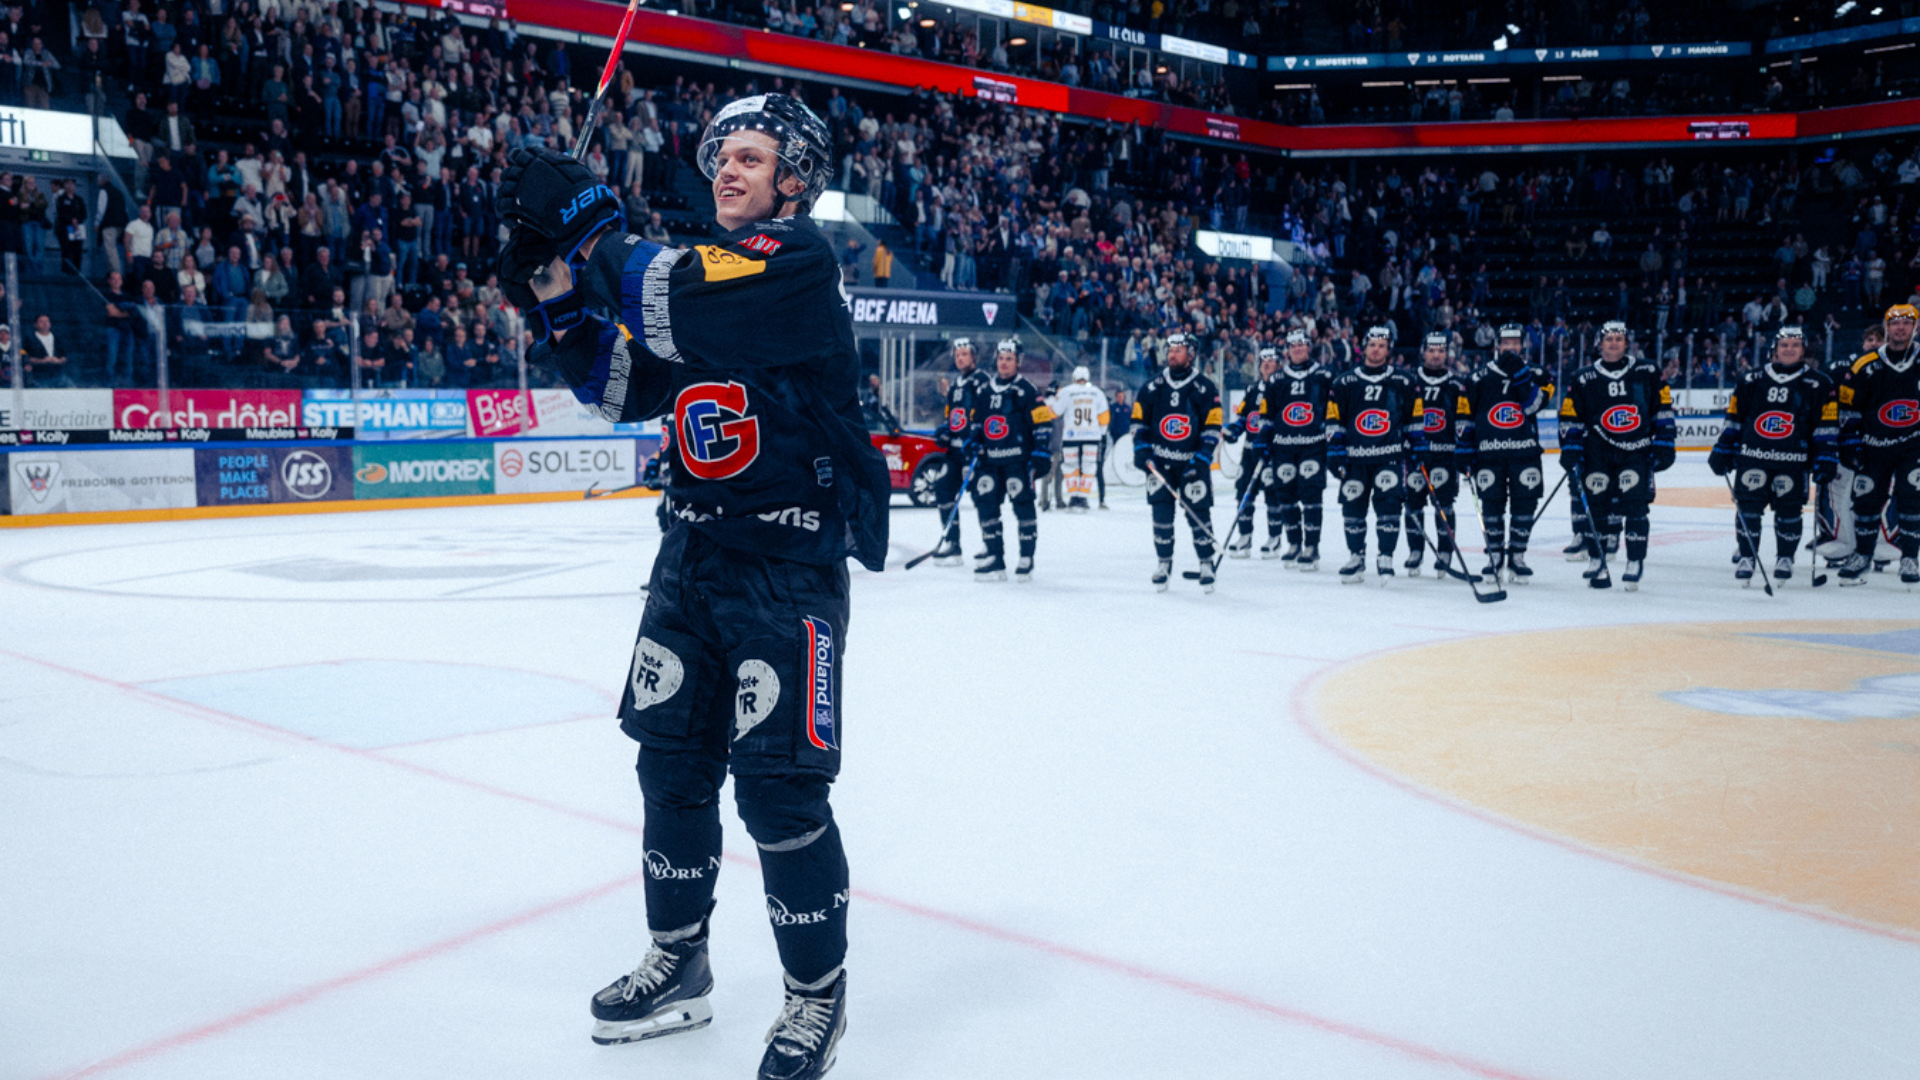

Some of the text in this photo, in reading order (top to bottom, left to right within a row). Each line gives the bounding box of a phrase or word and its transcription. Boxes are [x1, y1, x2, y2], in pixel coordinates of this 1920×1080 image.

[853, 298, 938, 325] BCF ARENA
[1290, 381, 1306, 395] 21
[1364, 385, 1383, 401] 27
[1424, 386, 1440, 401] 77
[1501, 379, 1511, 395] 7
[1608, 380, 1627, 397] 61
[1767, 386, 1789, 403] 93
[1170, 391, 1180, 407] 3
[22, 408, 108, 428] Fiduciaire
[122, 398, 208, 429] Cash
[303, 402, 429, 428] STEPHAN
[1074, 407, 1092, 426] 94
[36, 430, 69, 445] Kolly
[109, 428, 211, 443] Meubles Kolly
[246, 428, 338, 440] Meubles Kolly
[219, 454, 269, 469] PEOPLE
[528, 449, 625, 474] SOLEOL
[219, 470, 258, 484] MAKE
[389, 459, 491, 483] MOTOREX
[61, 477, 126, 488] FRIBOURG
[220, 484, 269, 499] PLACES
[817, 633, 831, 706] Roland
[636, 665, 660, 693] FR
[740, 675, 759, 690] et+
[647, 857, 704, 880] WORK
[767, 902, 828, 926] WORK
